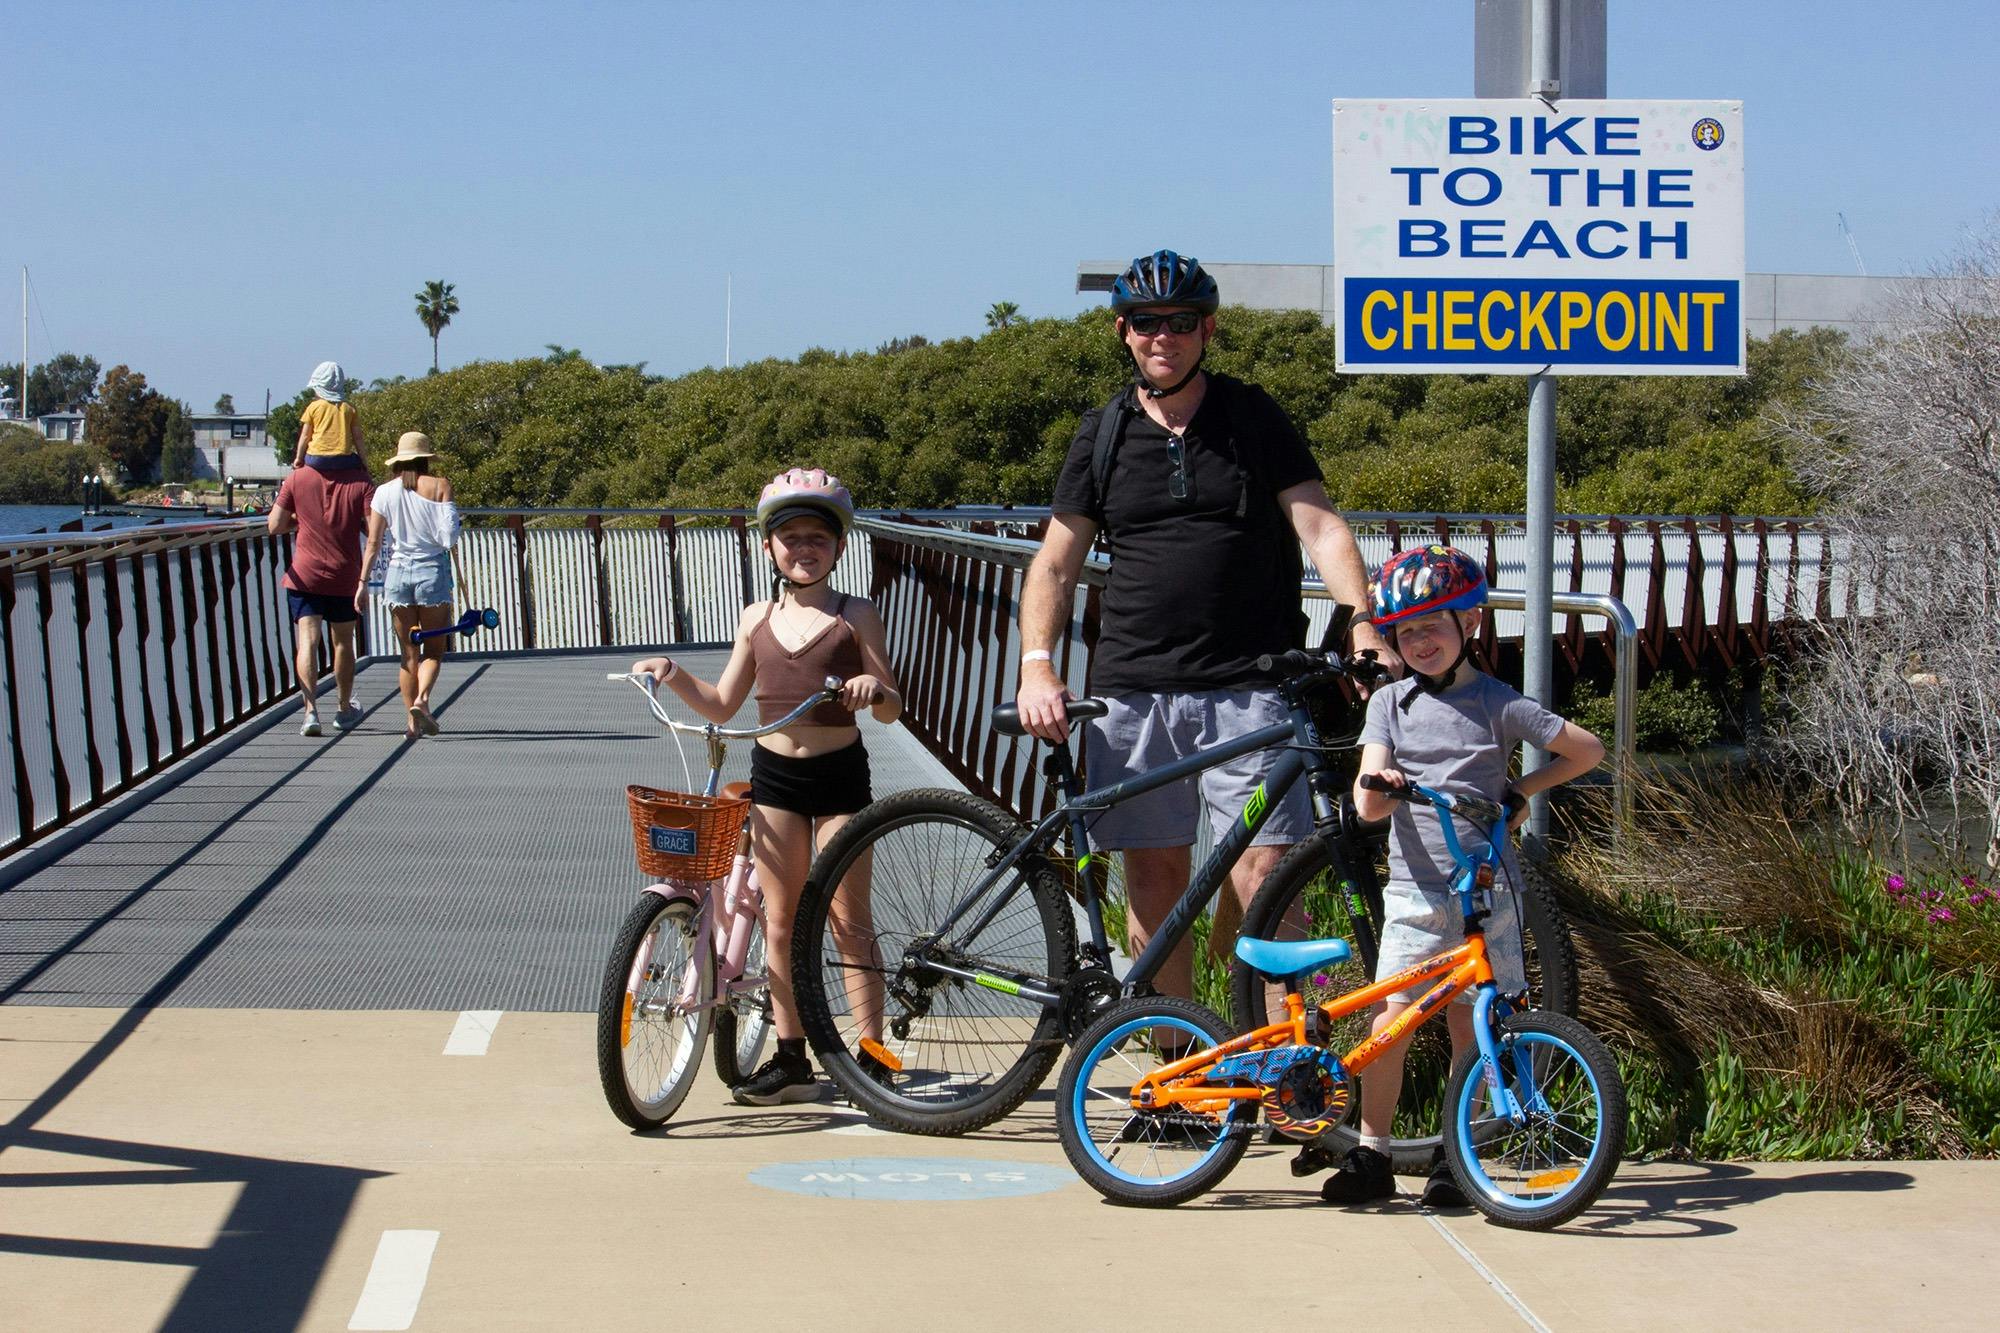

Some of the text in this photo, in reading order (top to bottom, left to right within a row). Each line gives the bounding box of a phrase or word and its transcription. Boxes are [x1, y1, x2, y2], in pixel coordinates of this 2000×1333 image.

[1449, 116, 1640, 156] BIKE
[1391, 167, 1694, 208] TO THE
[1399, 219, 1688, 259] BEACH
[1361, 289, 1725, 352] CHECKPOINT
[657, 835, 689, 851] GRACE
[800, 1171, 1027, 1183] SLOW
